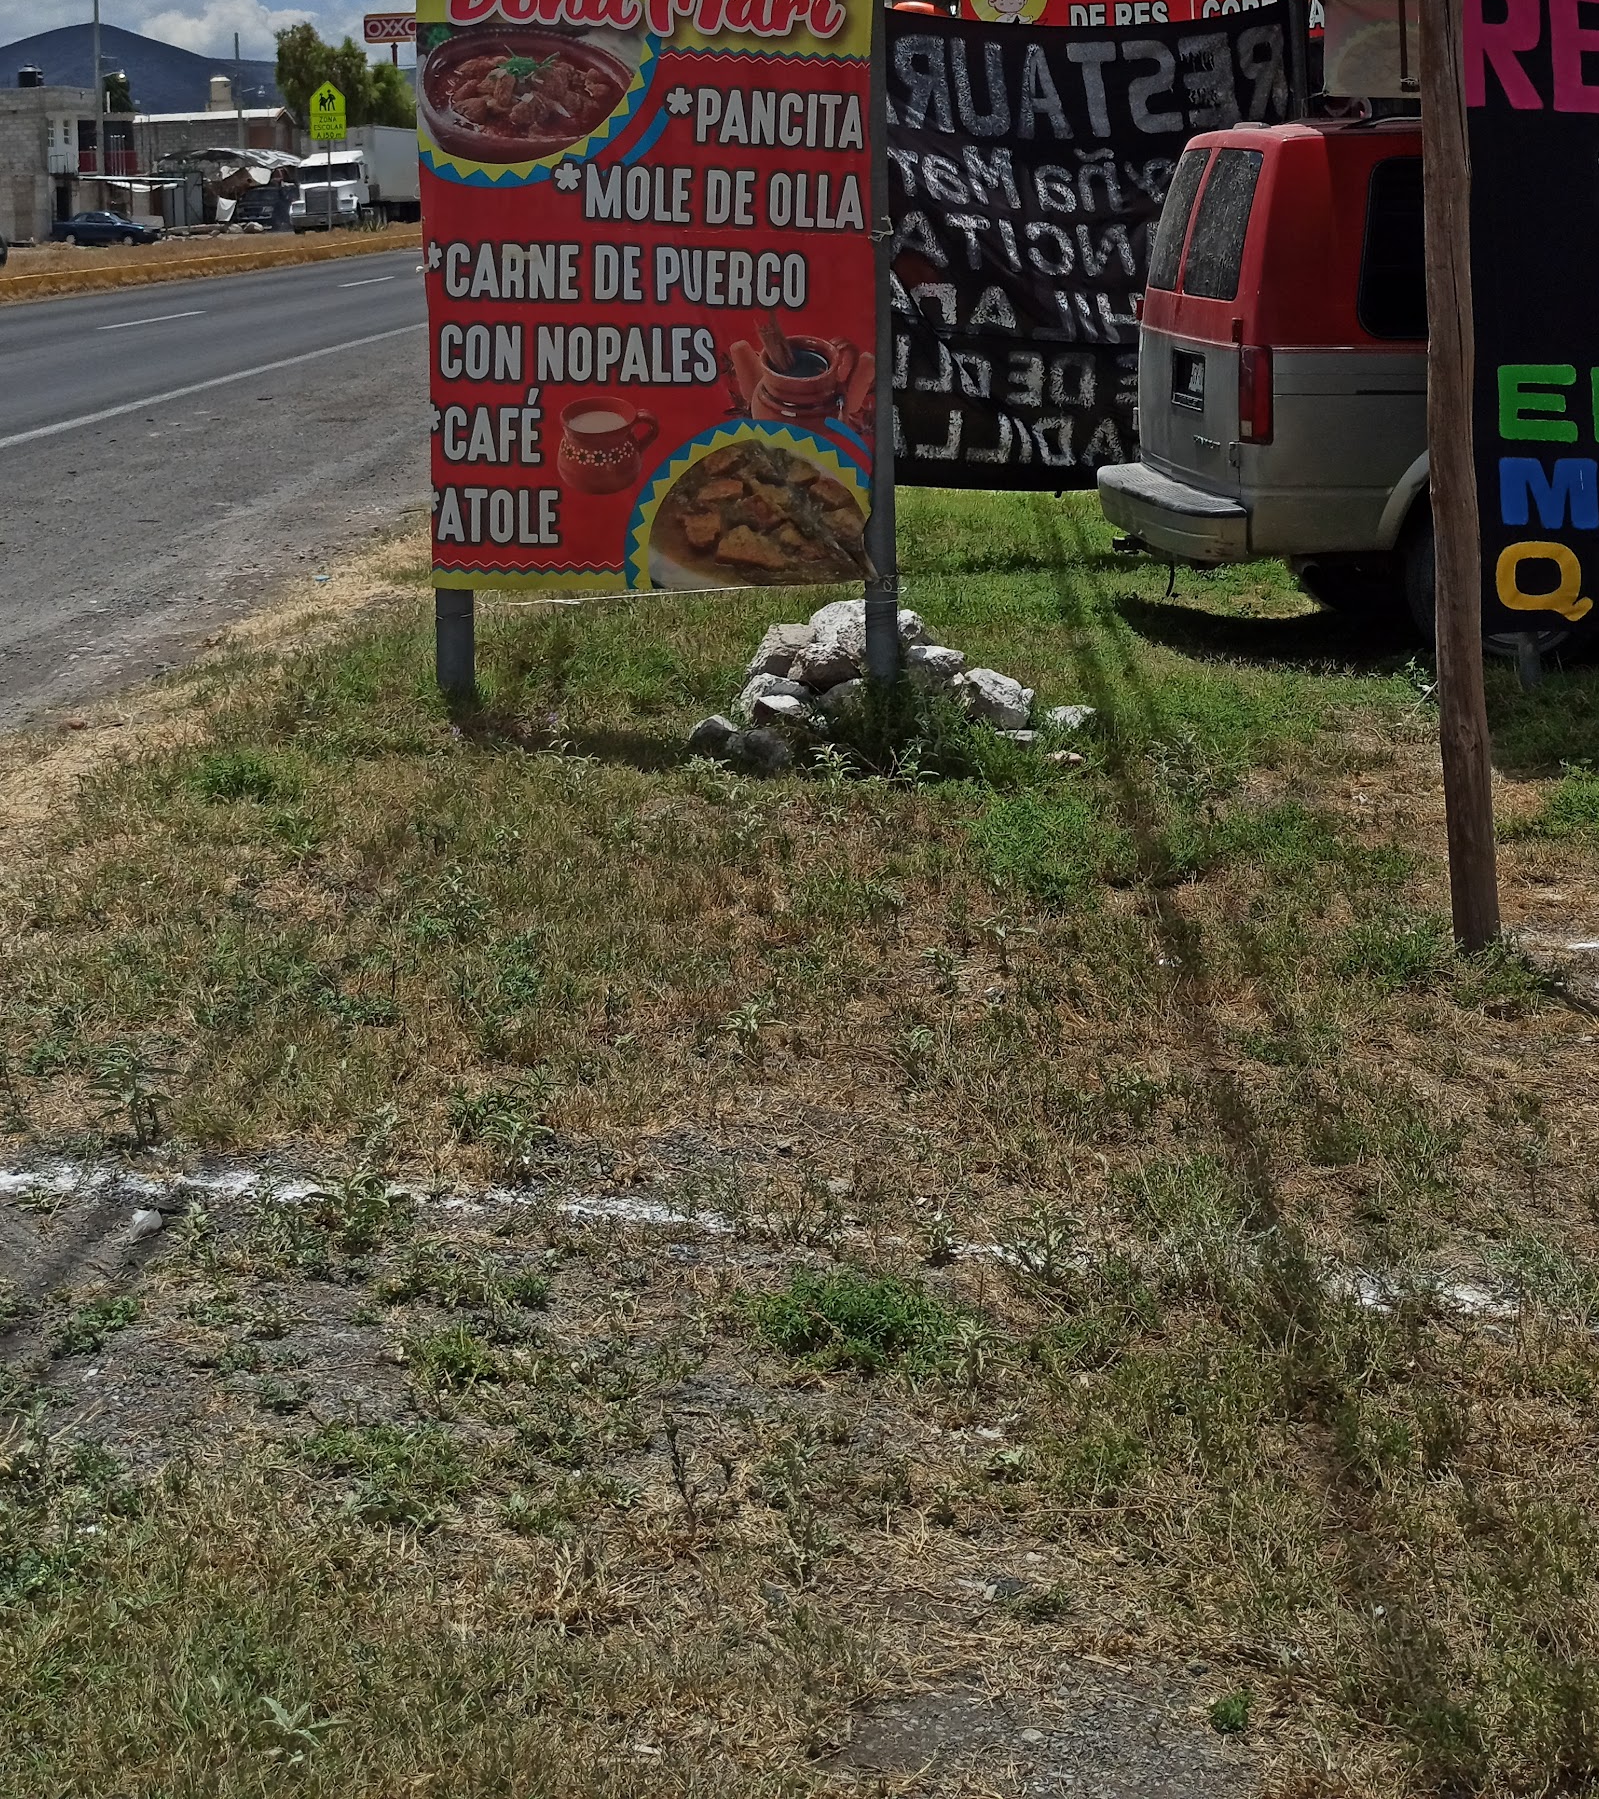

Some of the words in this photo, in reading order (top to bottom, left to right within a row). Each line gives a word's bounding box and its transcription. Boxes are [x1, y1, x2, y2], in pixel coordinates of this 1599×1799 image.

[1070, 4, 1106, 26] DE
[1115, 1, 1169, 26] RES
[319, 116, 337, 124] ZONA
[706, 169, 756, 226] DE
[769, 172, 864, 230] OLLA
[594, 244, 643, 301] DE
[656, 246, 807, 309] PUERCO
[440, 324, 522, 382] CON
[537, 326, 718, 384] NOPALES
